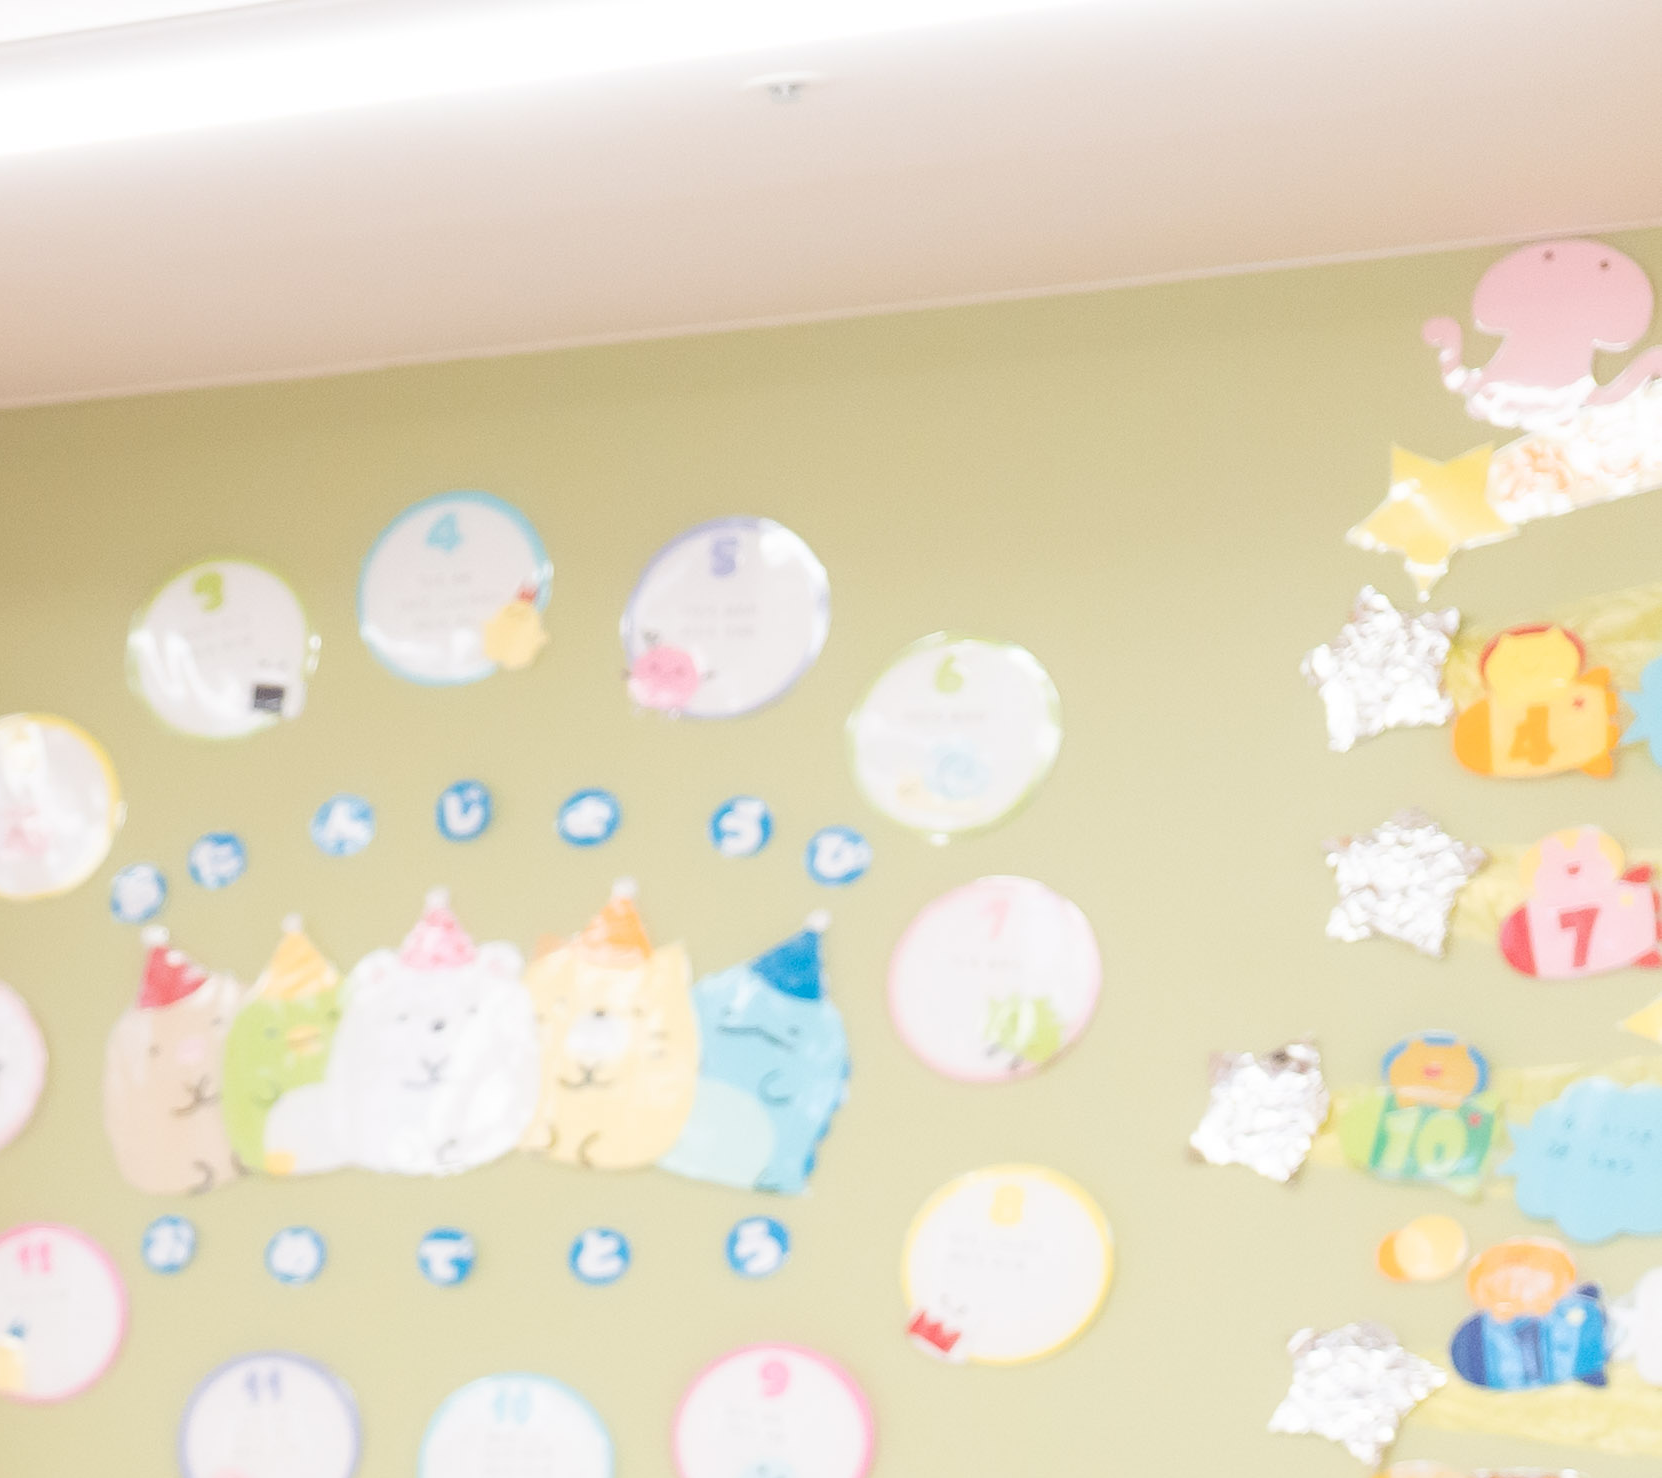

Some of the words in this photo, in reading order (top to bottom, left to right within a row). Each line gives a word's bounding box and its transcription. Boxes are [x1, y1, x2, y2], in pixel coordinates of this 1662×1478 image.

[426, 512, 464, 553] 4
[935, 653, 965, 694] 6
[1509, 704, 1555, 767] 4
[1558, 906, 1600, 969] 7
[1384, 1105, 1469, 1175] 10
